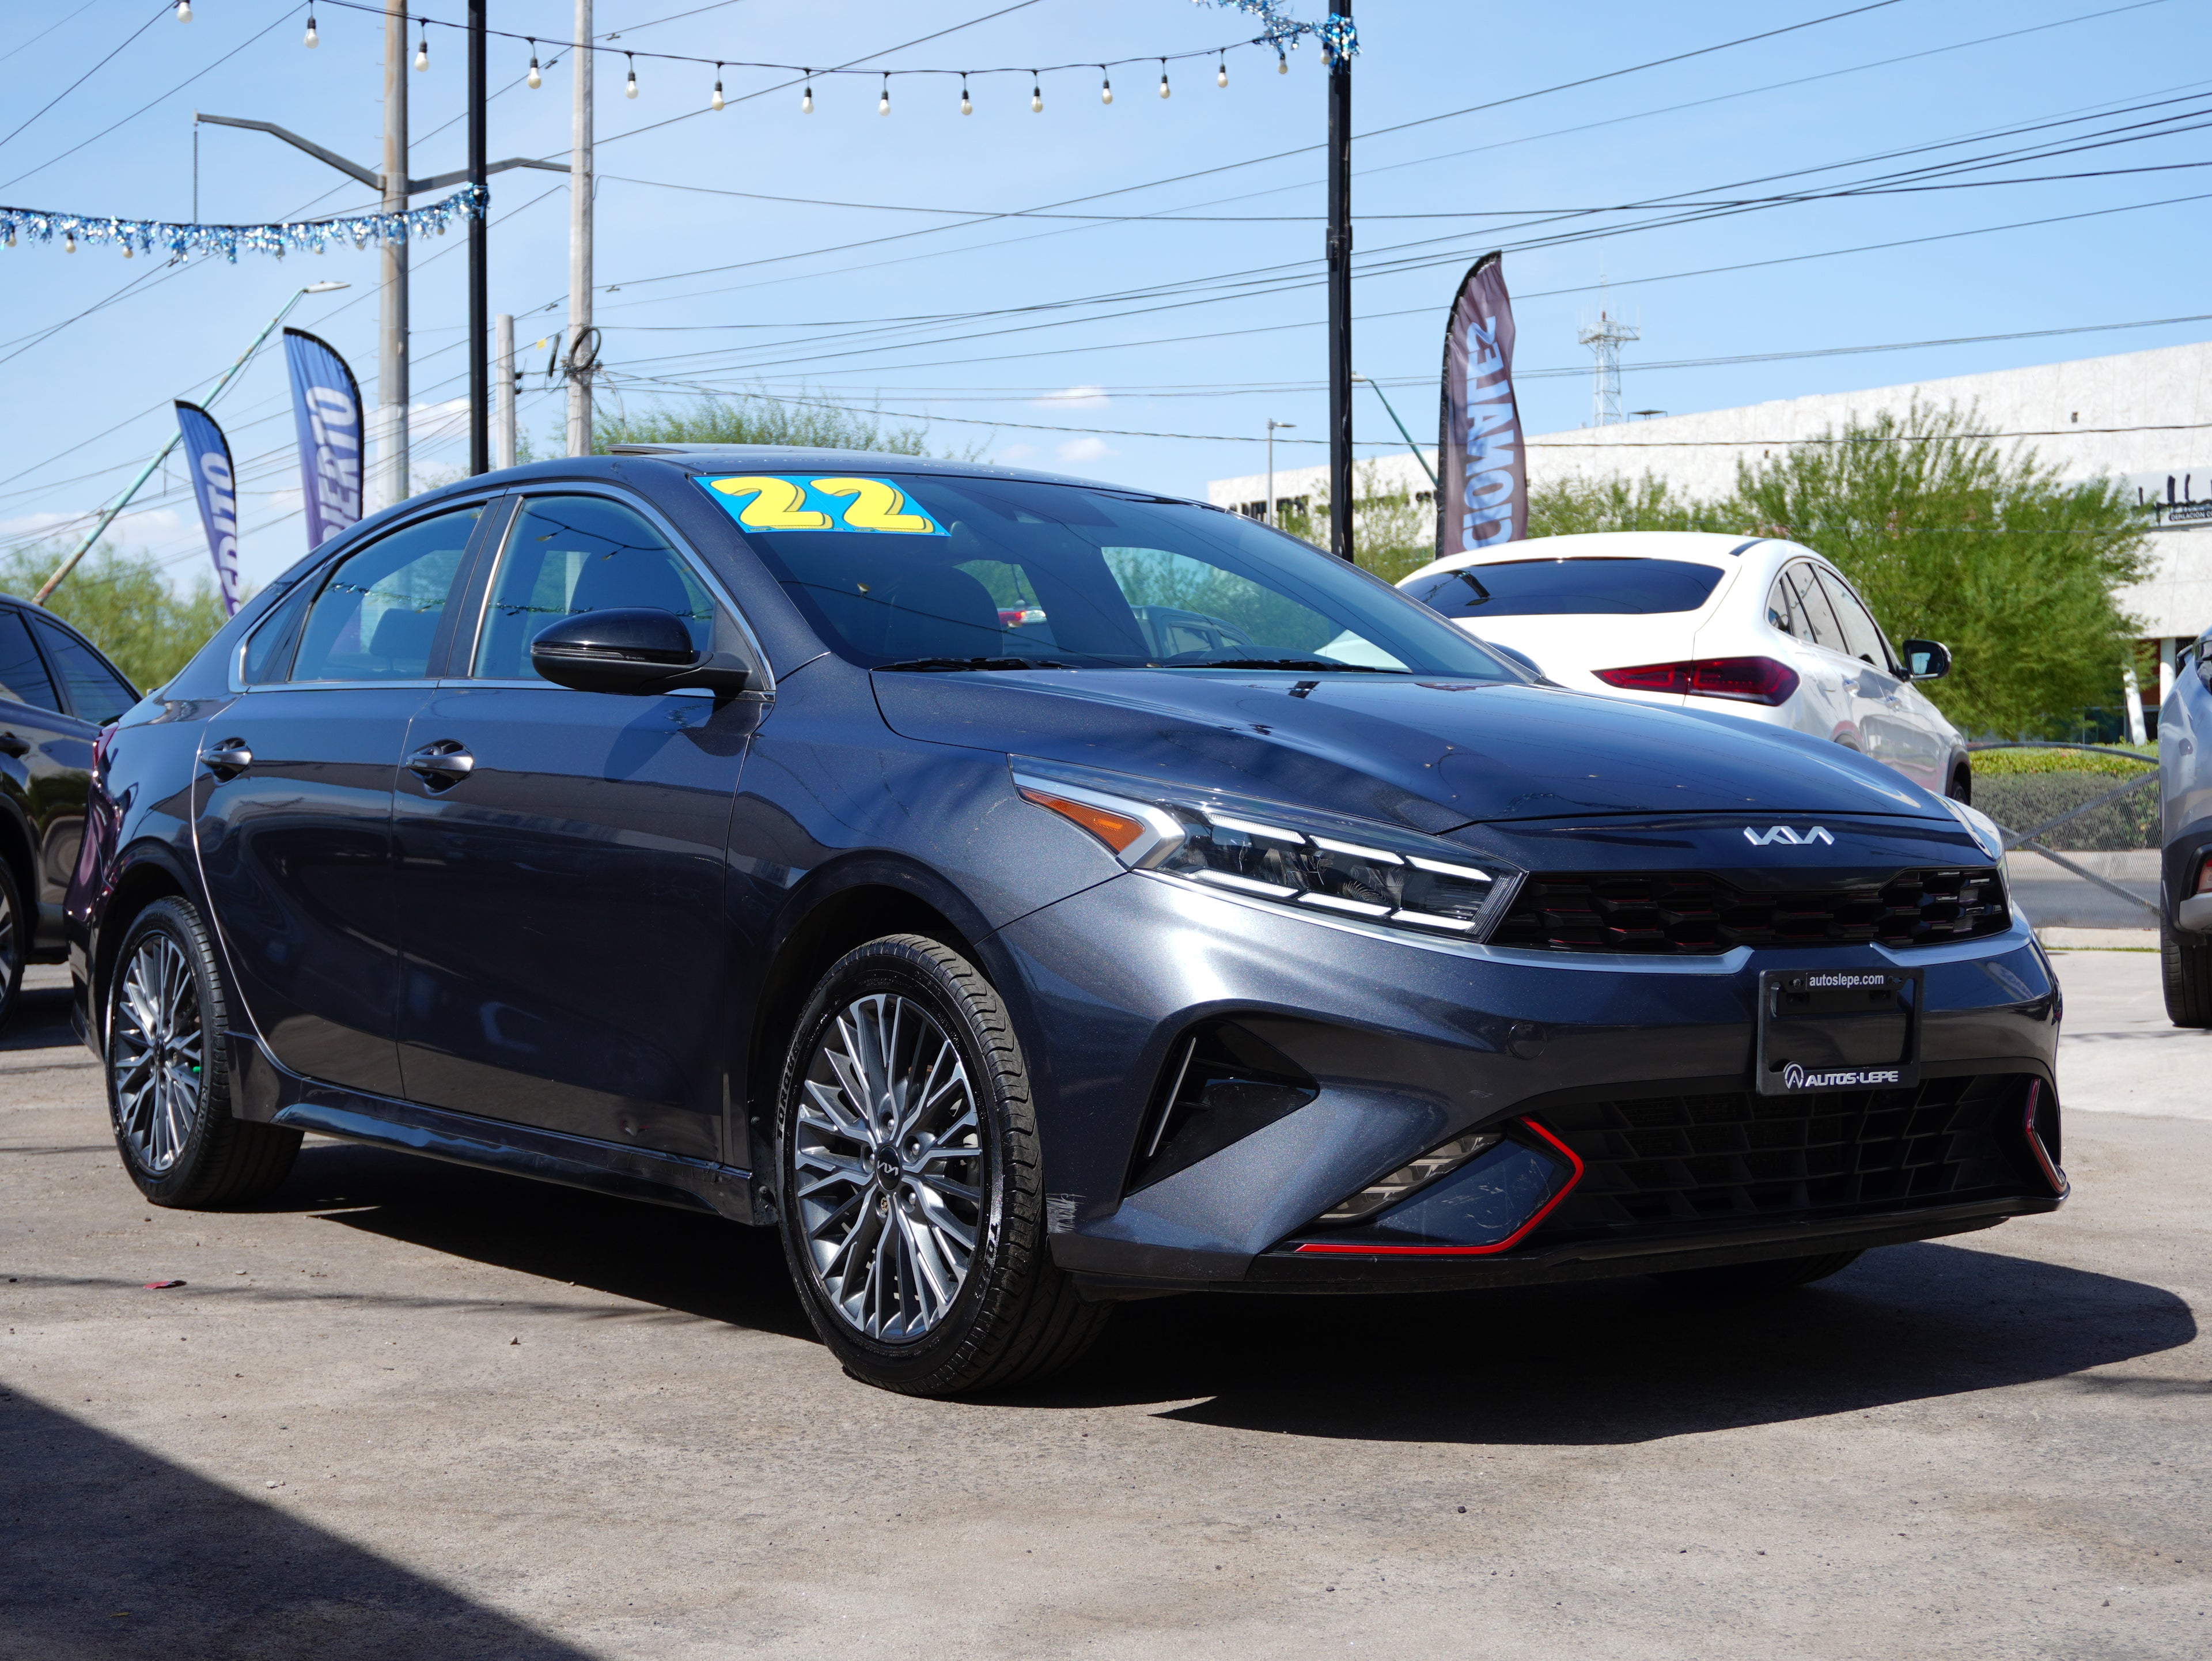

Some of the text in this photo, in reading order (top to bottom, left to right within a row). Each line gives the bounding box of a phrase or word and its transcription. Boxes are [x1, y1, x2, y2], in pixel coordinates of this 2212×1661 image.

[710, 476, 935, 533] 22
[1744, 826, 1835, 845] KIA
[1809, 973, 1884, 988] autoslepe.com
